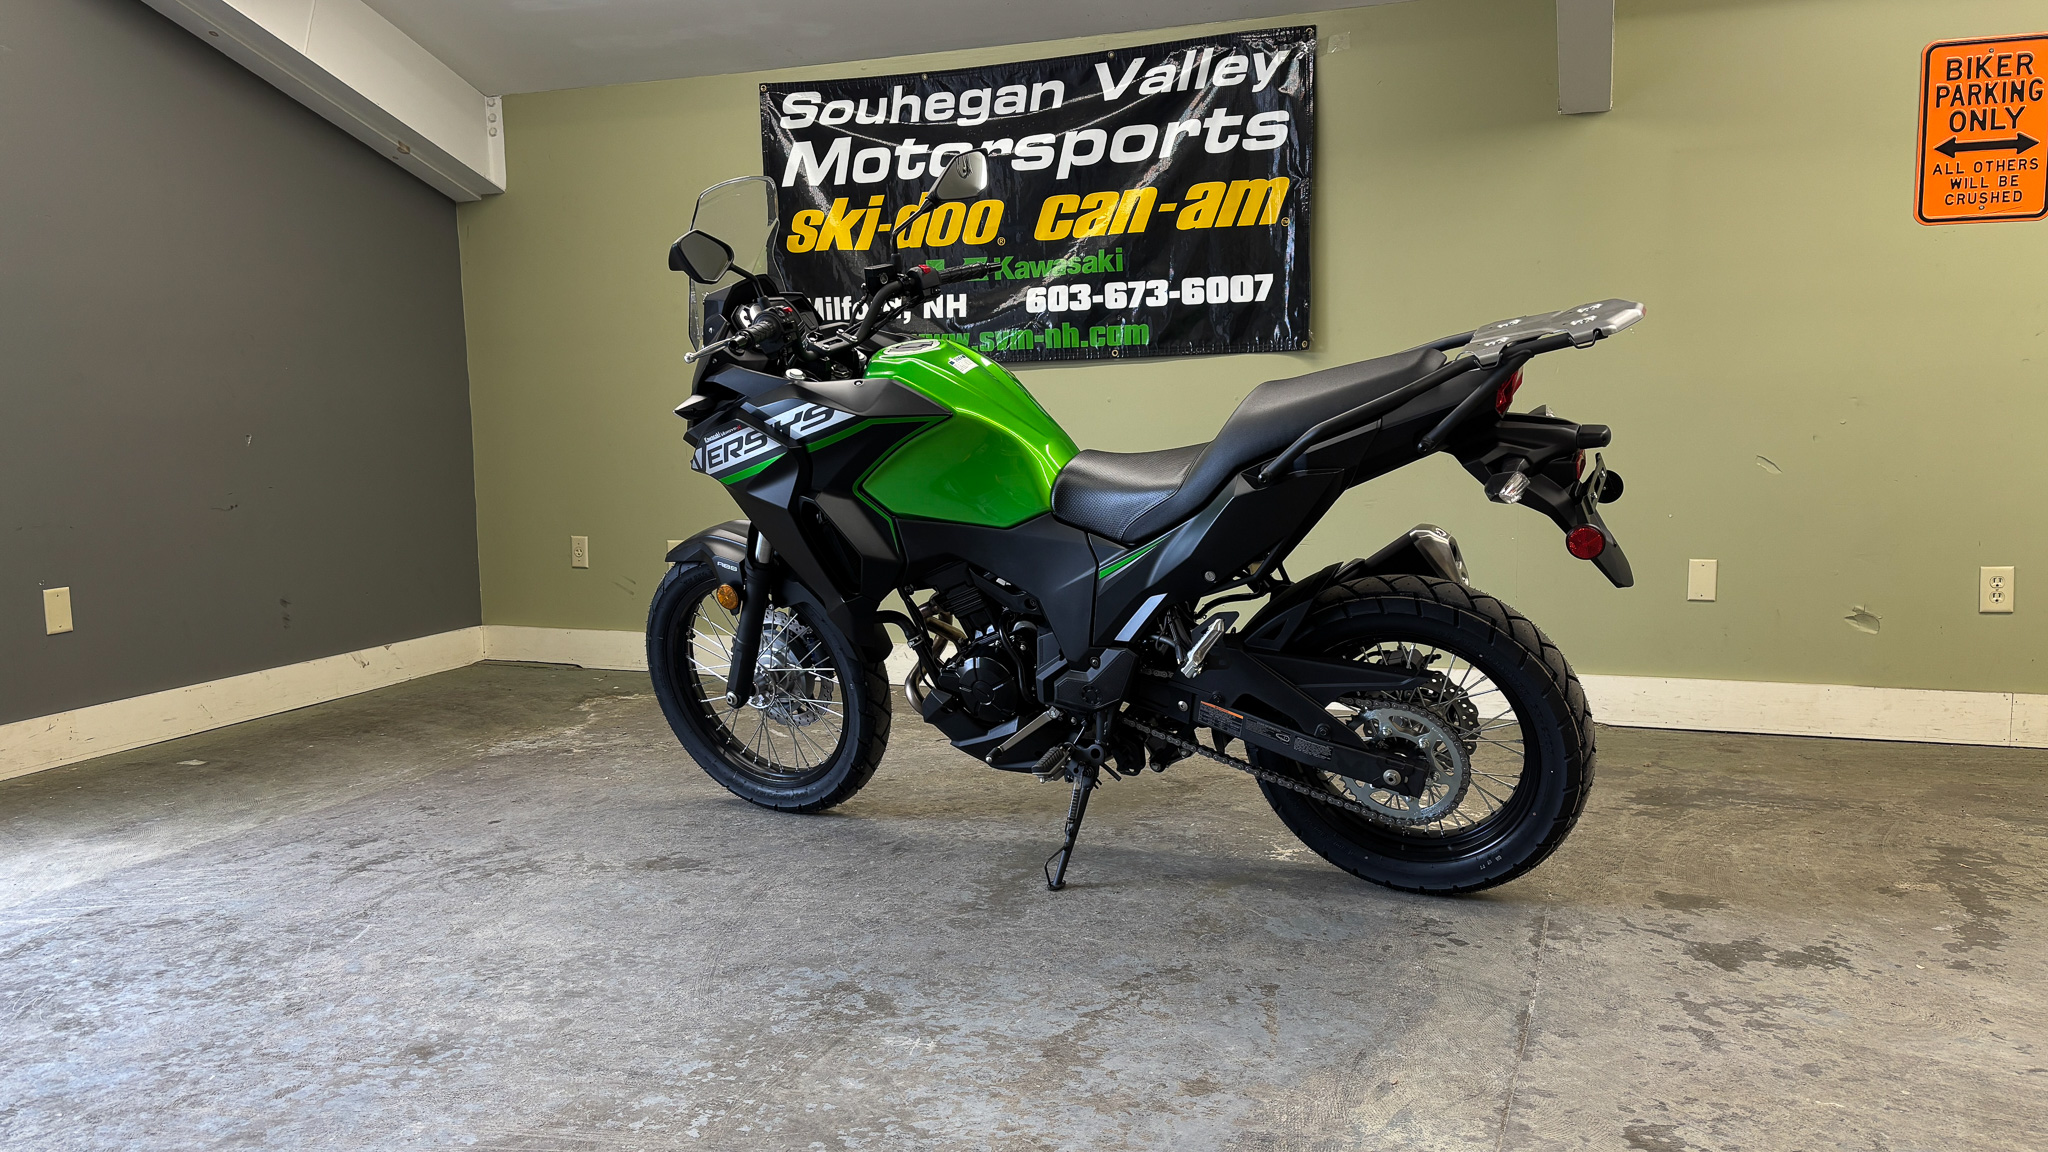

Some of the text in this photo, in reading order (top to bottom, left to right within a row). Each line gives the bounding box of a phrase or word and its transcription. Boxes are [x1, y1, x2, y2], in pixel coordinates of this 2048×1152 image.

[1946, 53, 2034, 81] BIKER
[780, 49, 1290, 129] Souhegan Valley
[1935, 78, 2044, 109] PARKING
[1949, 105, 2026, 133] ONLY
[1932, 157, 2039, 176] ALL OTHERS
[1950, 174, 2019, 190] WILL BE
[1944, 189, 2023, 206] CRUSHED
[994, 247, 1124, 281] Kawasaki
[923, 293, 968, 319] NH
[1025, 274, 1275, 315] 603-673-6007
